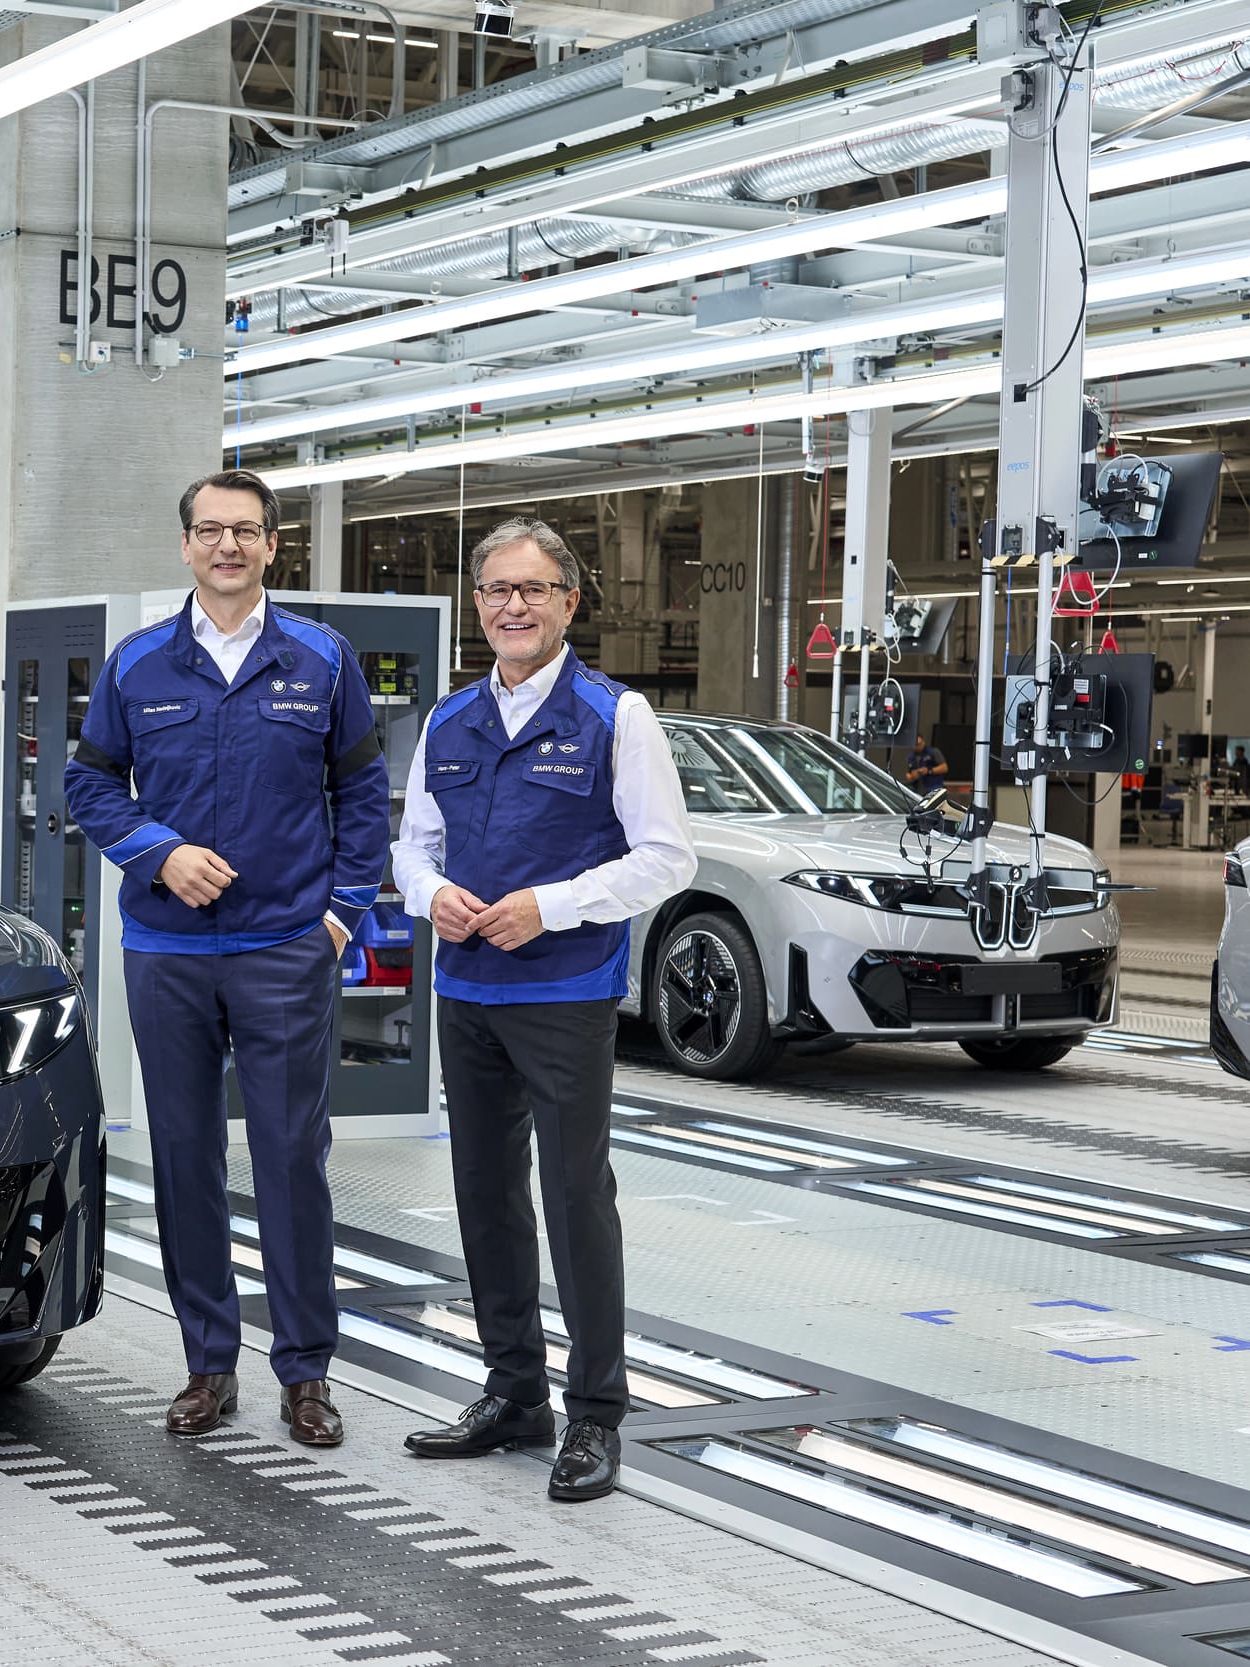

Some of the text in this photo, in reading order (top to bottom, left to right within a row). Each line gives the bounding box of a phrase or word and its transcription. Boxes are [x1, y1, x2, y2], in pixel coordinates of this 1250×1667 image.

[701, 562, 745, 593] CC10
[272, 703, 319, 712] BMW GROUP
[554, 765, 584, 775] GROUP
